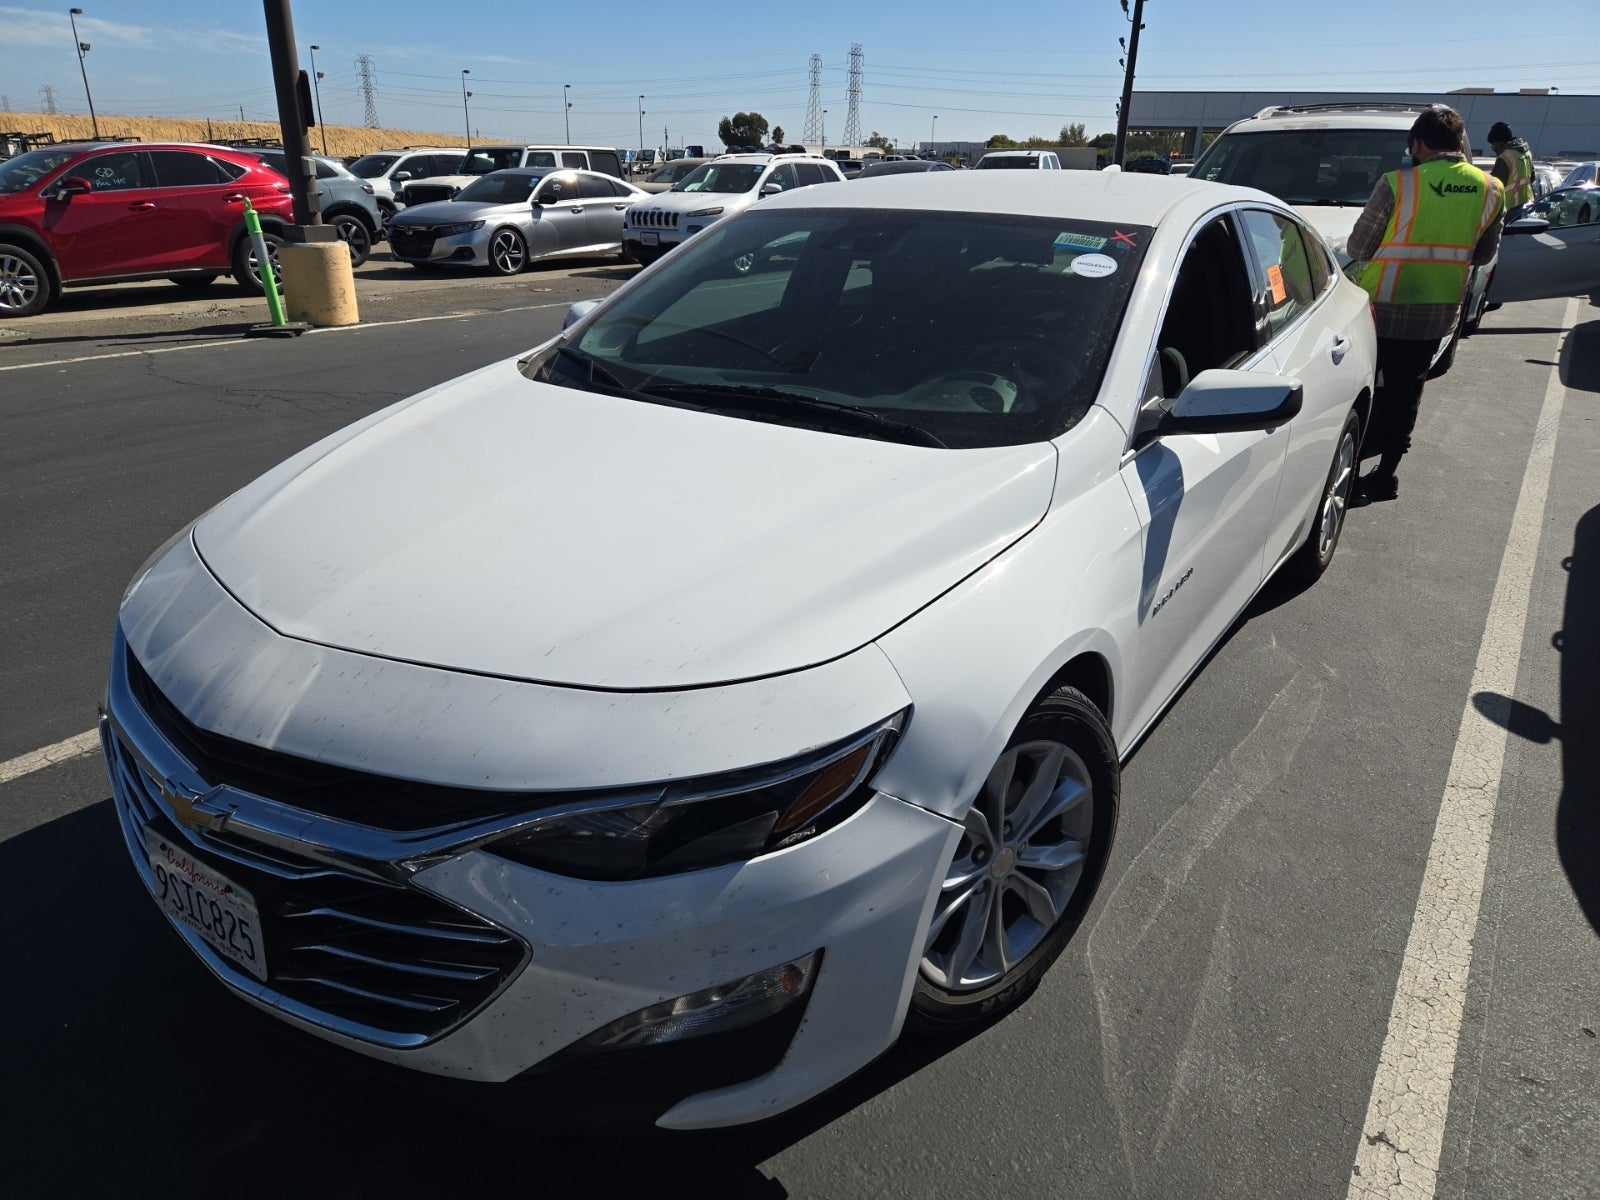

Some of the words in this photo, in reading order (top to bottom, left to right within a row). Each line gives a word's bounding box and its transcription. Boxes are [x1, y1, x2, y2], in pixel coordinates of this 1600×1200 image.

[1444, 183, 1478, 193] ADESA
[166, 849, 231, 896] California
[156, 863, 256, 960] 9SIC825
